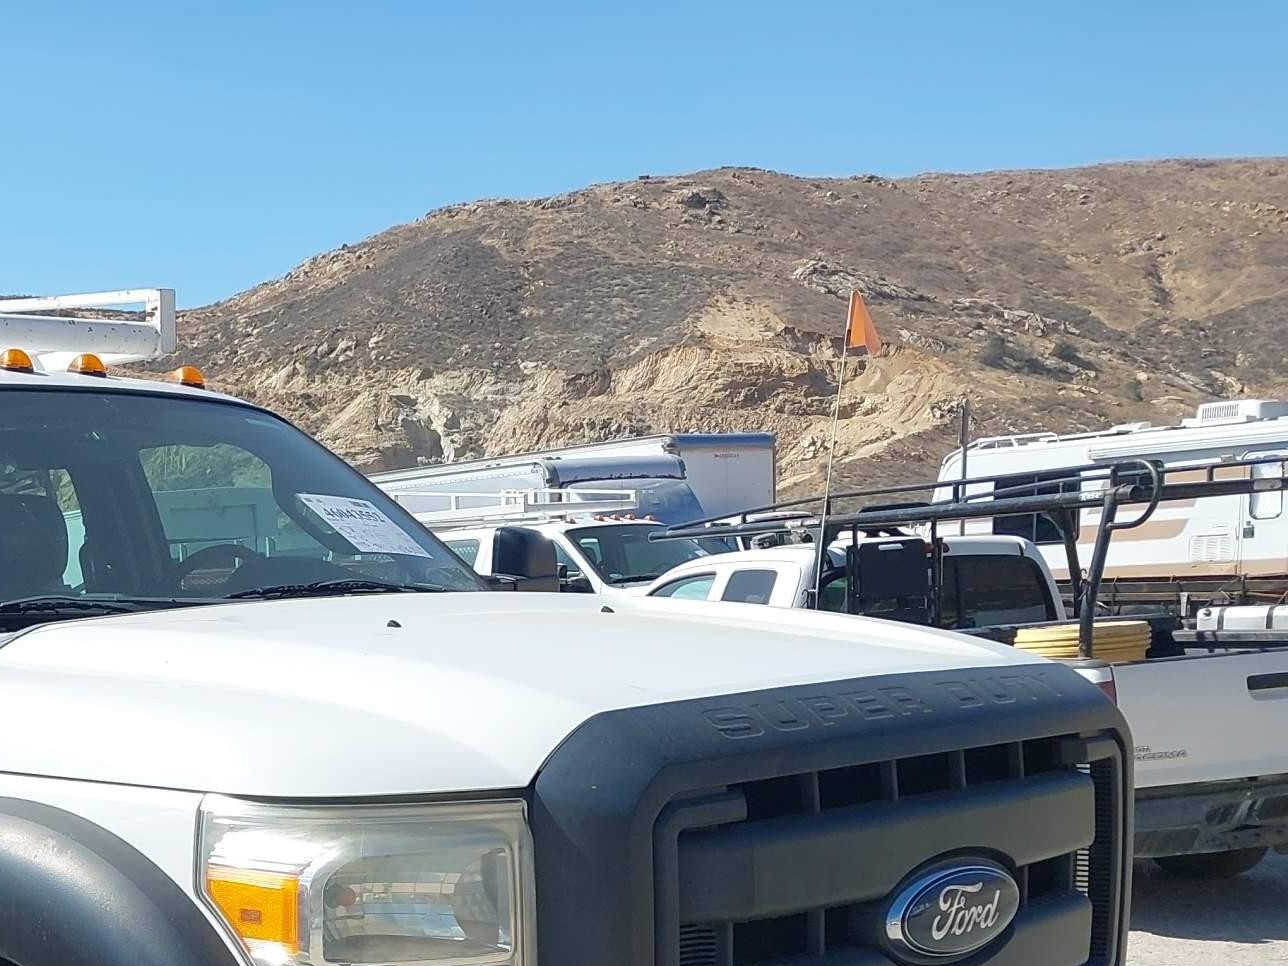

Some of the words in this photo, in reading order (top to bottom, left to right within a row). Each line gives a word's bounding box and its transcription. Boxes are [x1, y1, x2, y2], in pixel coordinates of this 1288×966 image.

[699, 685, 934, 740] SUPER
[934, 672, 1062, 709] DUTY
[932, 881, 1001, 941] Ford
